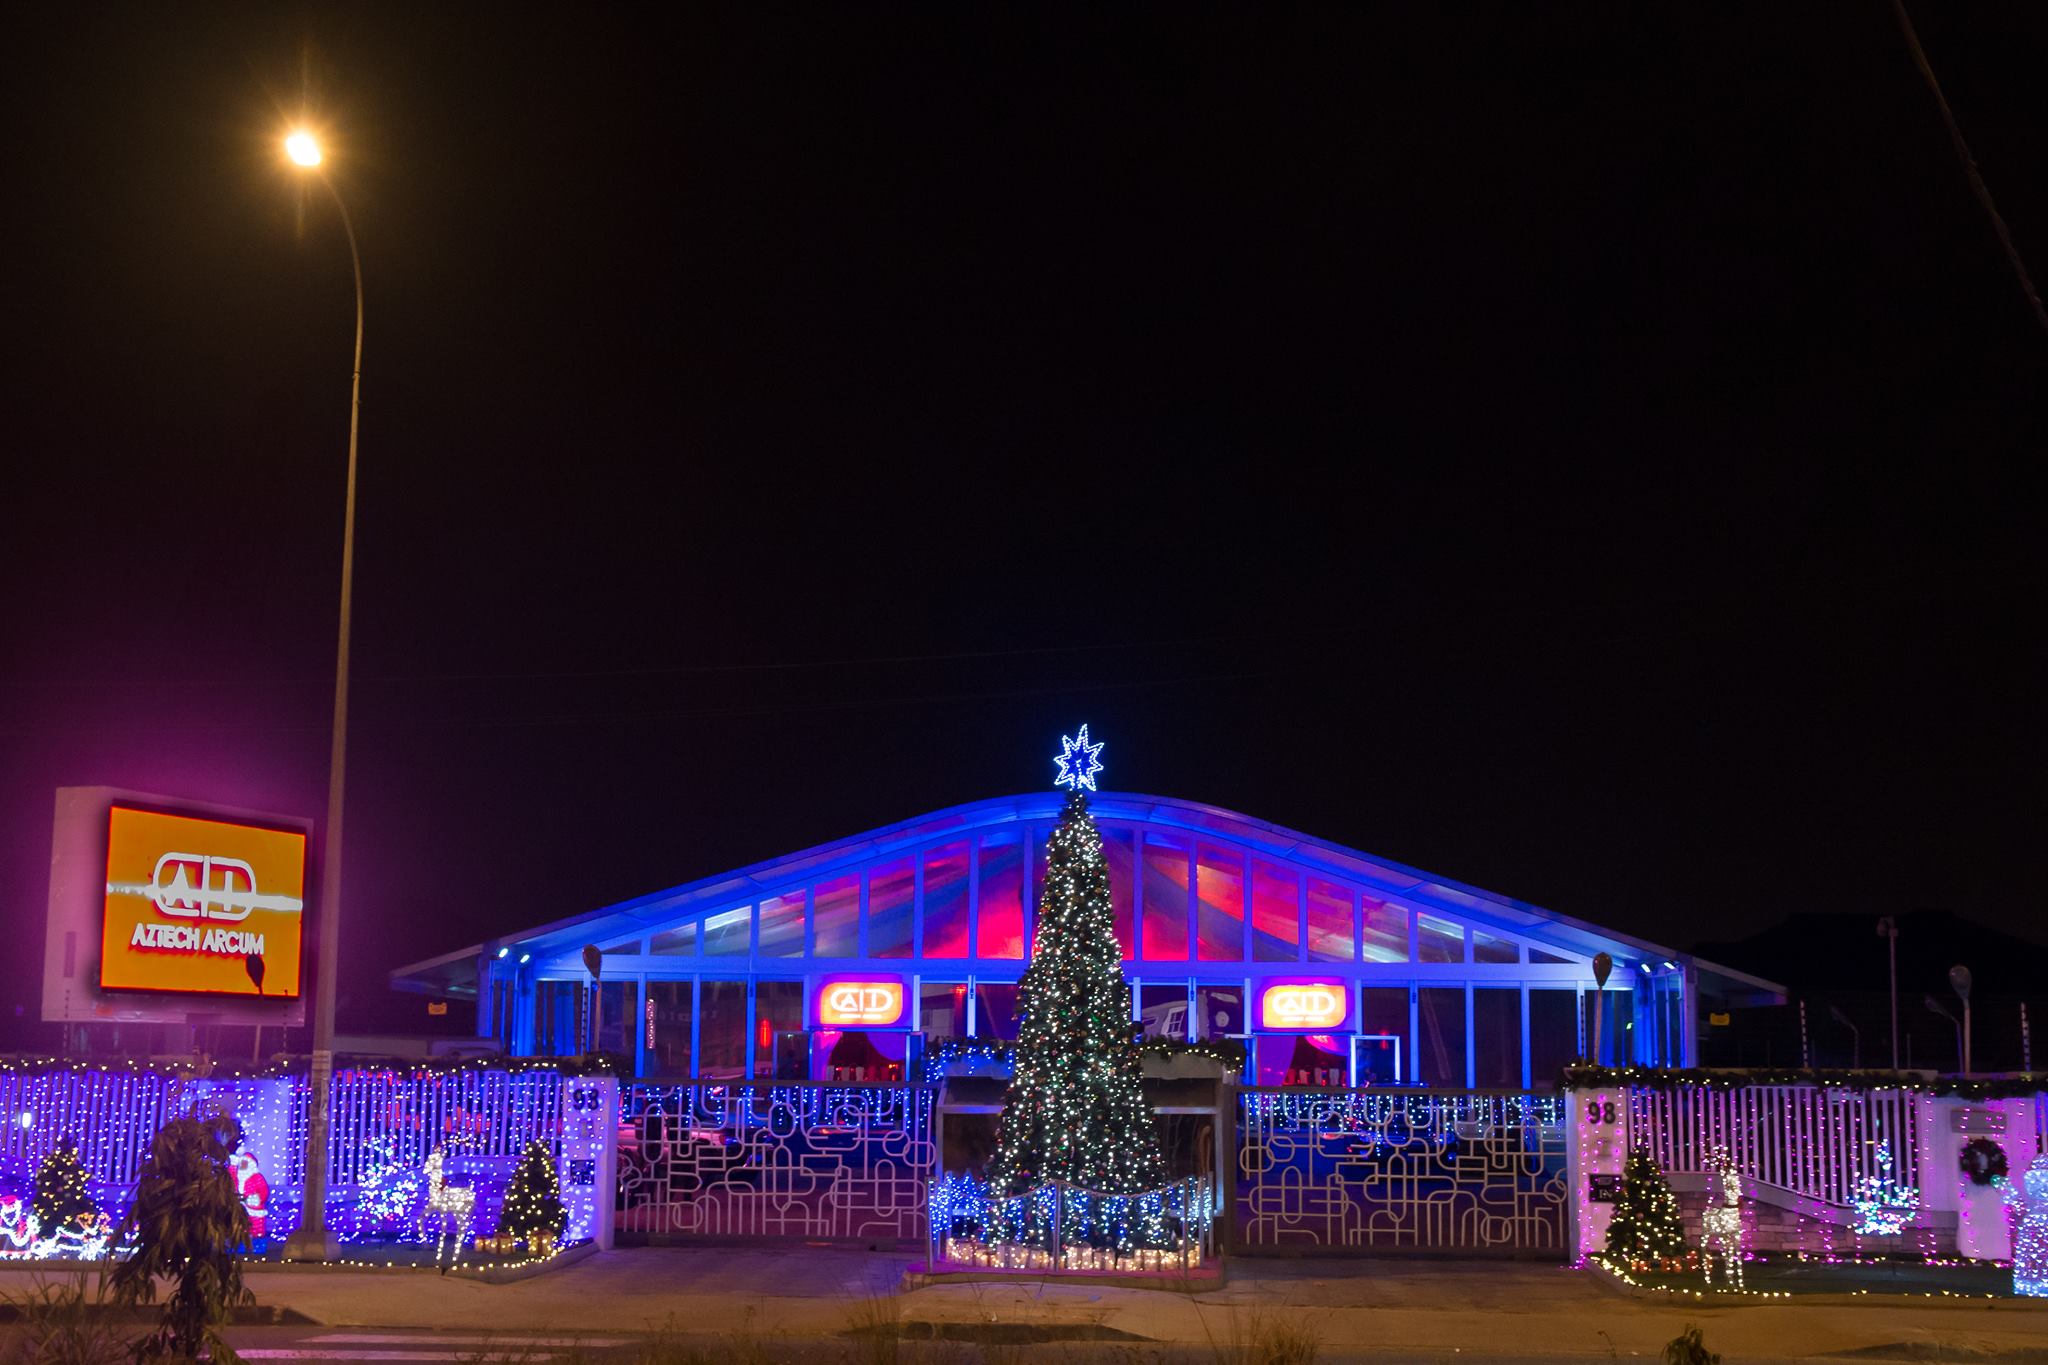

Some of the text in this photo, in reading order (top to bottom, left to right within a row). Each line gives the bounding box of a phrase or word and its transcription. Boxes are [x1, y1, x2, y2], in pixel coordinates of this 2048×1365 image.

[131, 922, 265, 955] AZTECH ARCUM
[573, 1088, 599, 1111] 98
[1588, 1102, 1616, 1124] 98
